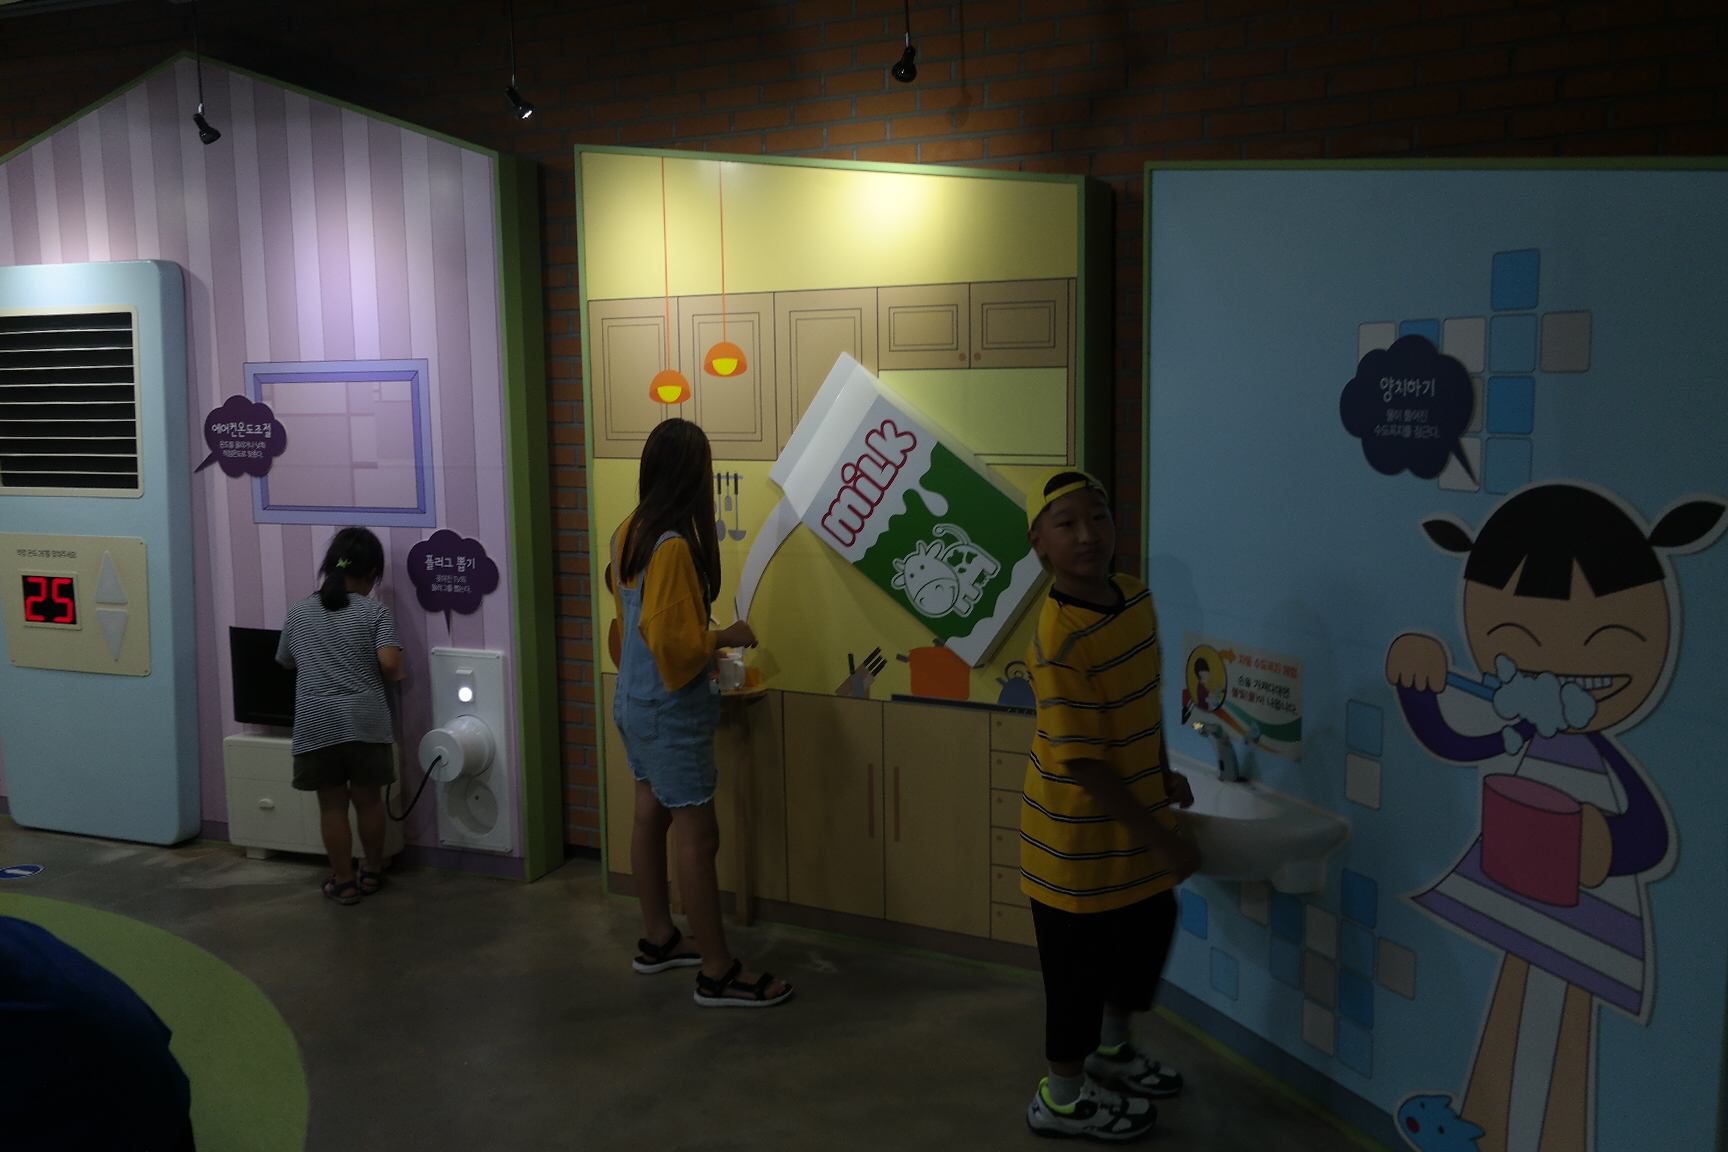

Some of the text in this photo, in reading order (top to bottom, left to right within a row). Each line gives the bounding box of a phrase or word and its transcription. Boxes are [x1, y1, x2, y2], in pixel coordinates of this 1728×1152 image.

[1379, 376, 1436, 403] 양치하기
[211, 421, 272, 438] 에어컨온도조절
[424, 554, 476, 573] 플러그 뽑기
[25, 577, 75, 623] 25
